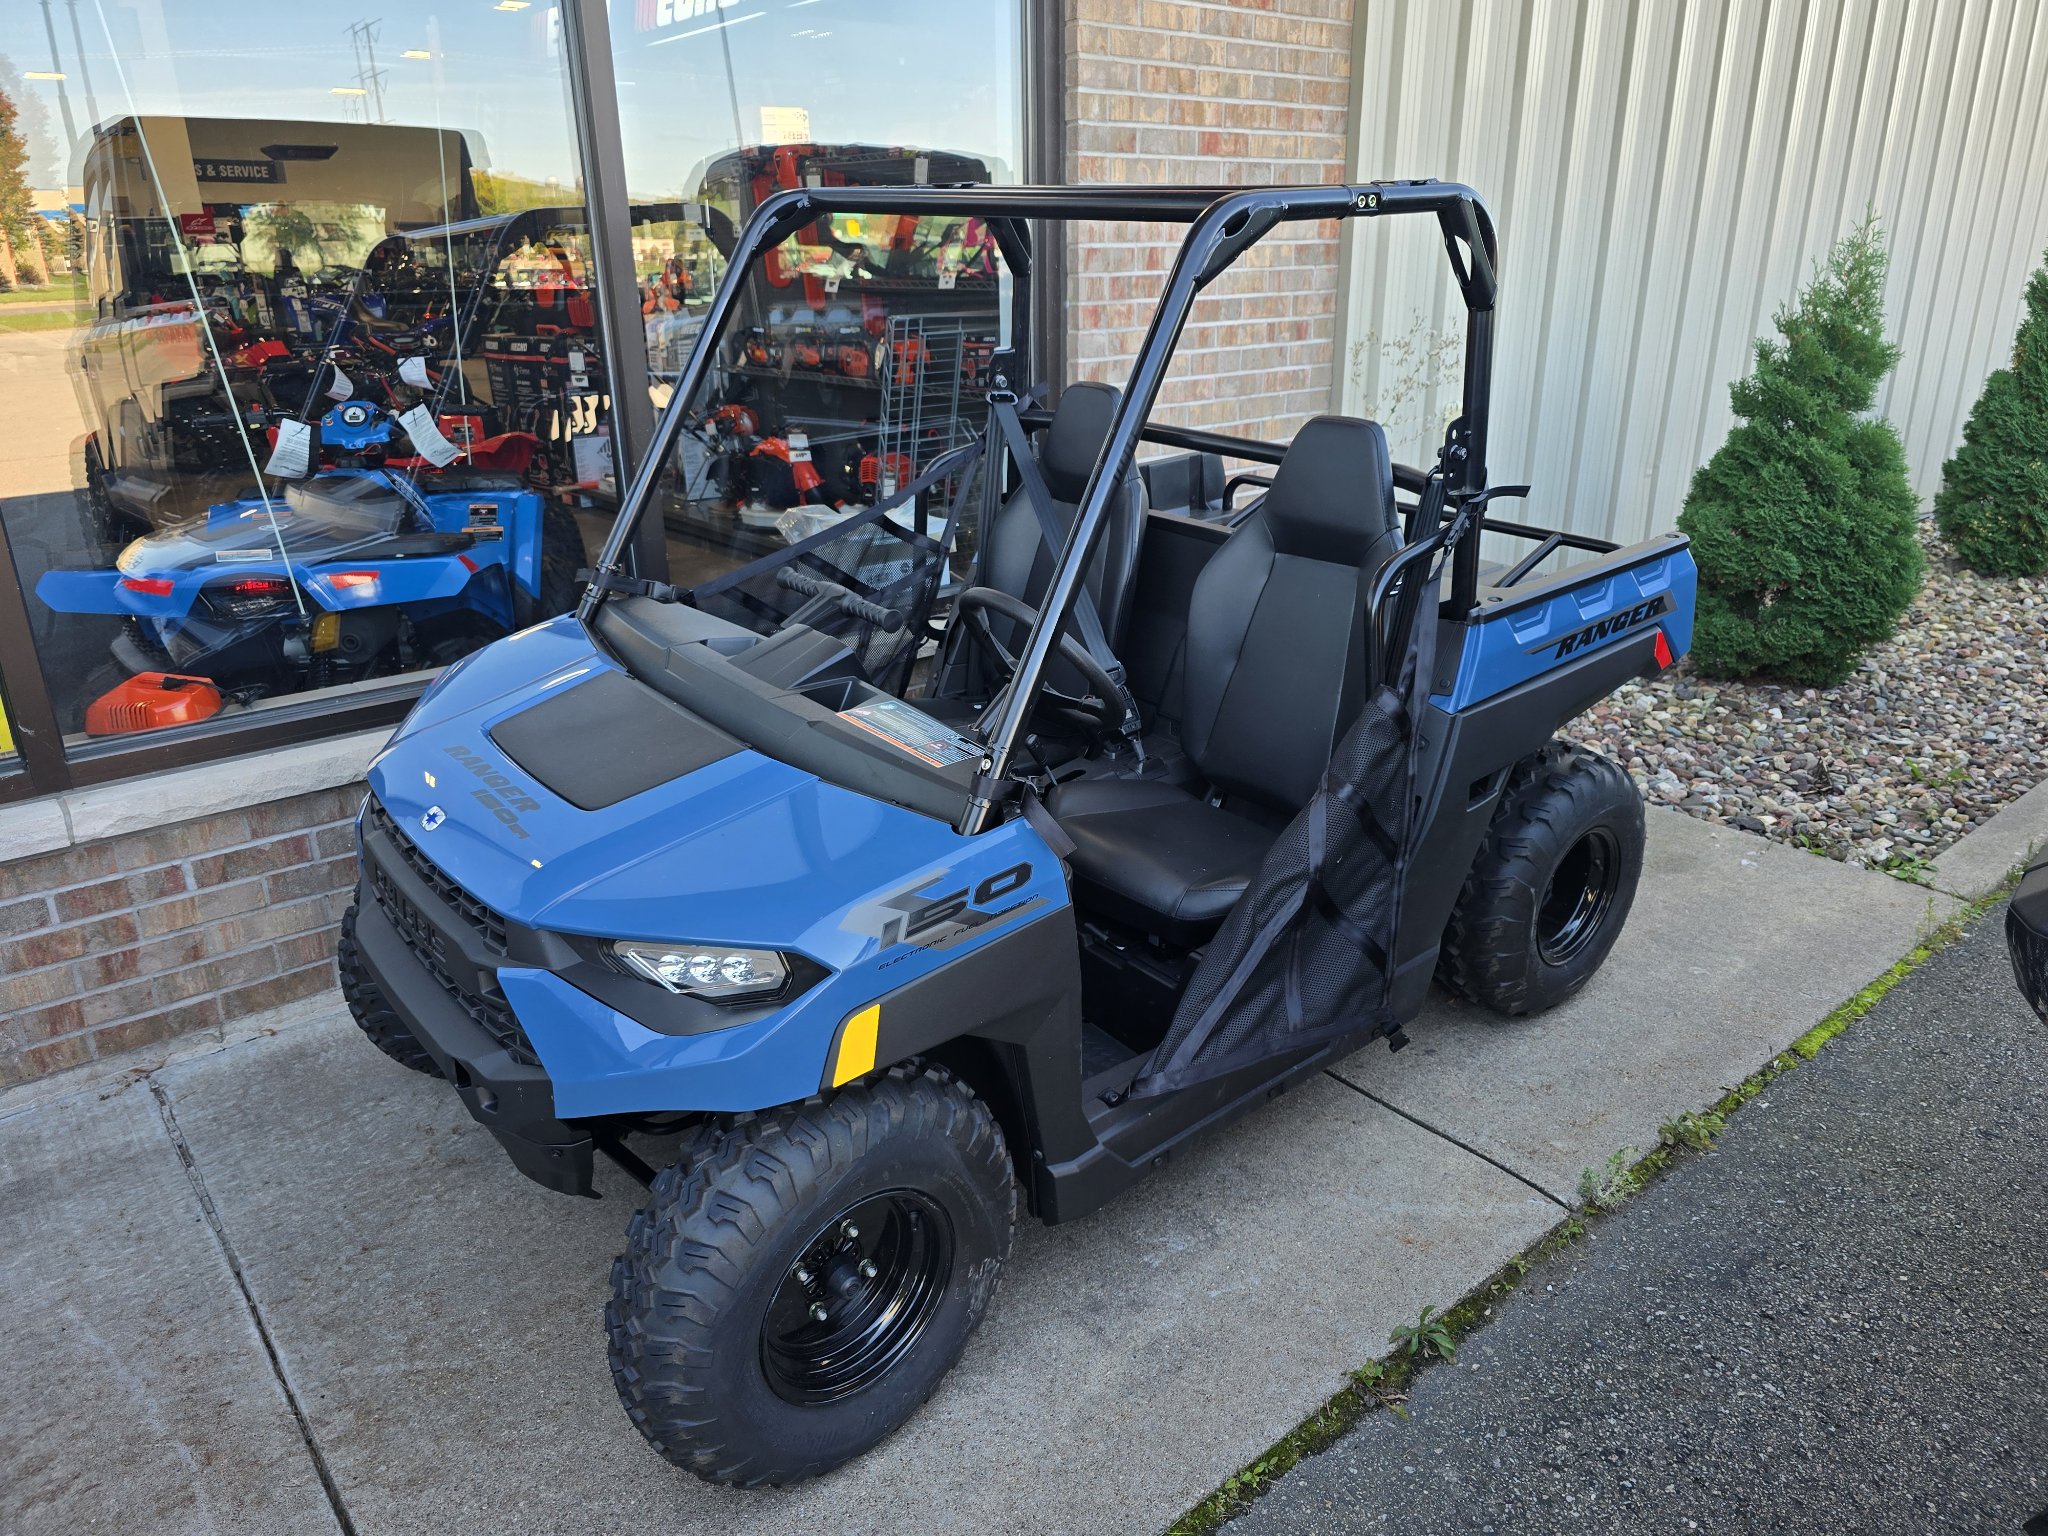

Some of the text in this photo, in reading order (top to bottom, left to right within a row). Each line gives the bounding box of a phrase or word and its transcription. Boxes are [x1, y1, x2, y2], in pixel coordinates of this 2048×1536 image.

[207, 164, 216, 176] &
[220, 165, 269, 178] SERVICE
[1553, 596, 1665, 660] RANGER
[442, 745, 541, 812] RANGER
[877, 935, 948, 971] ELECTRONIC
[953, 918, 983, 937] FUEL
